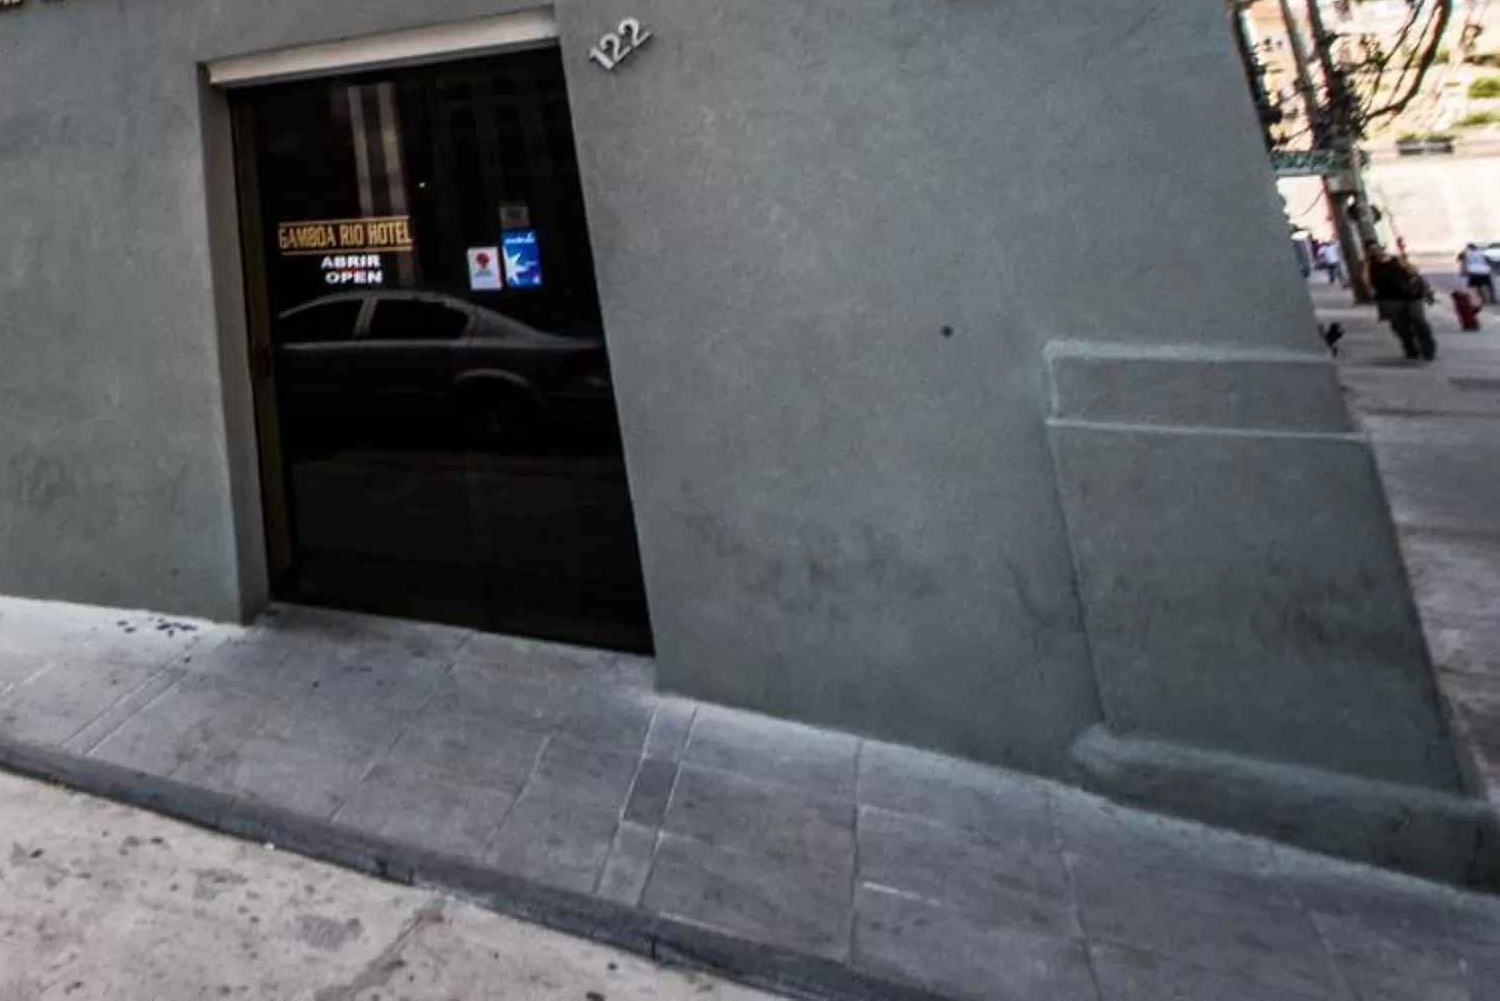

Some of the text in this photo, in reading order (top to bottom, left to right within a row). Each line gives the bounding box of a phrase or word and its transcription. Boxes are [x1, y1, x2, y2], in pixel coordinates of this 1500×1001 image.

[589, 17, 652, 70] 122
[279, 219, 413, 250] GAMBOA RIO HOTEL
[321, 254, 381, 269] ABRIR
[324, 270, 383, 285] OPEN
